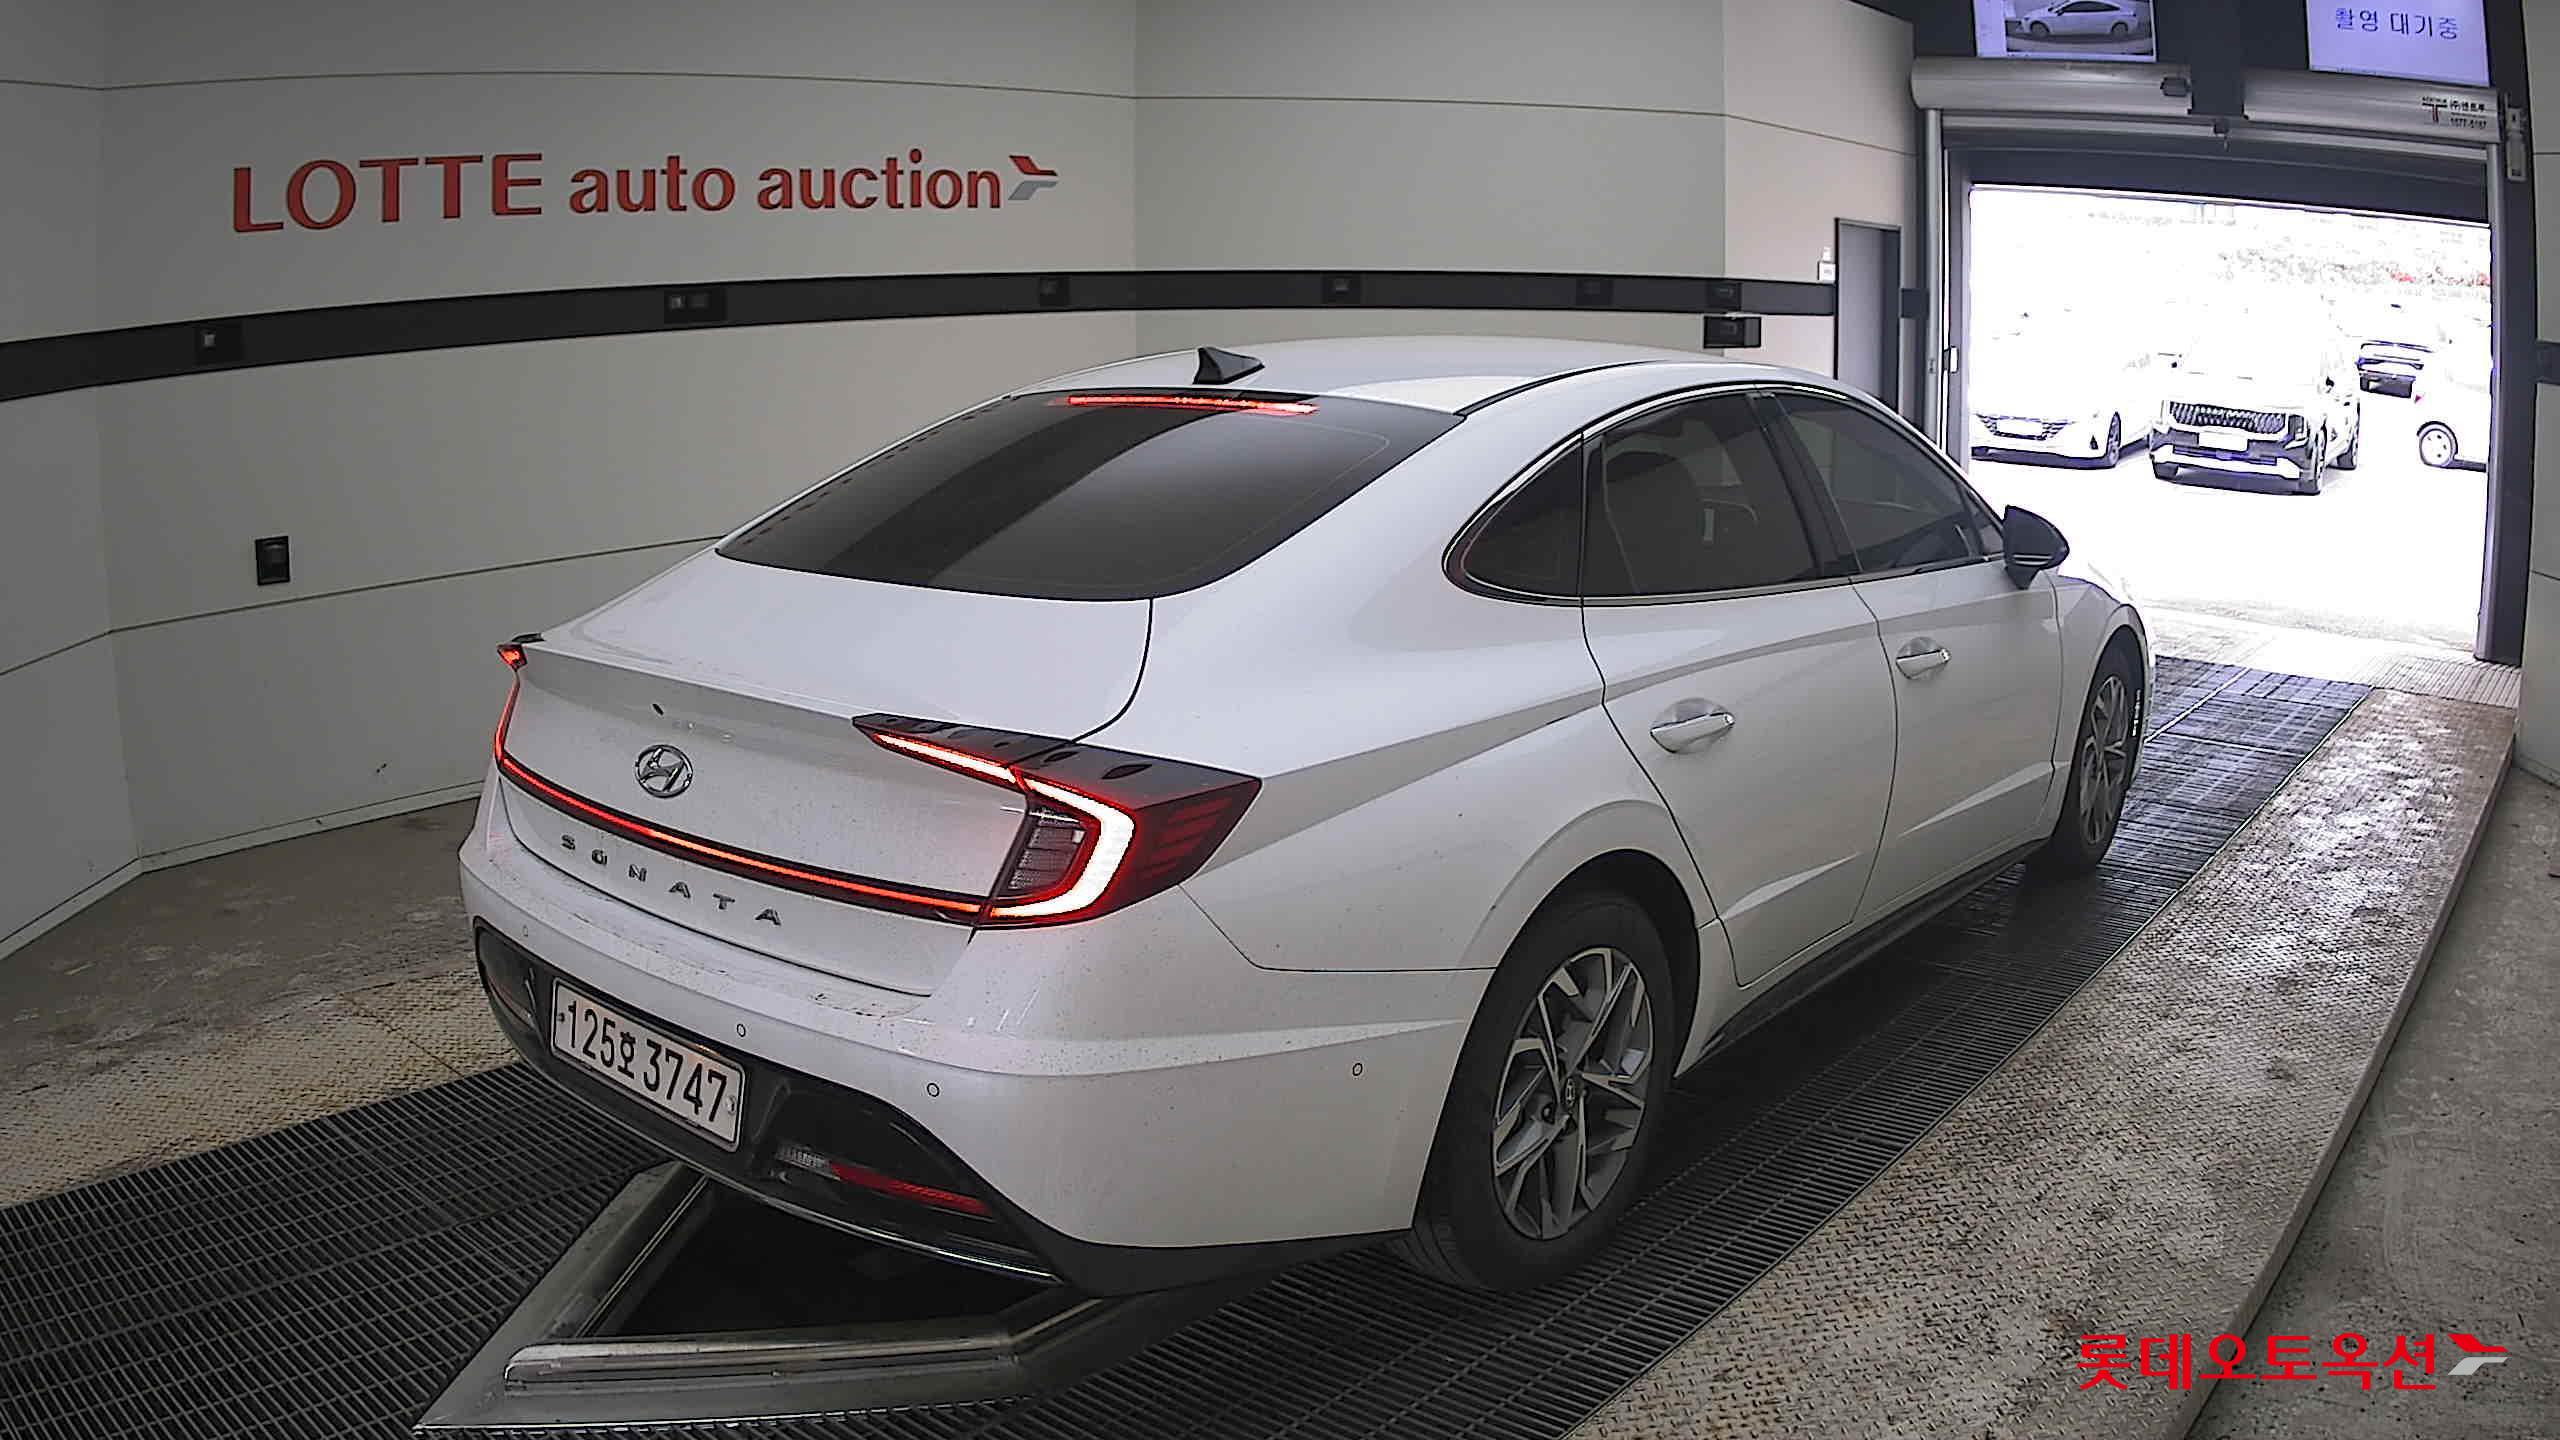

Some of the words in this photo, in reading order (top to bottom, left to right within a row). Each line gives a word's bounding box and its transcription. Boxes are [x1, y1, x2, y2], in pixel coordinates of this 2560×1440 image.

[2336, 8, 2379, 32] 촬영
[2389, 12, 2458, 40] 대기중
[233, 153, 543, 232] LOTTE
[568, 155, 736, 214] auto
[757, 148, 1002, 211] auction
[561, 834, 782, 927] SONATA
[567, 1000, 636, 1080] 125호
[643, 1038, 728, 1123] 3747
